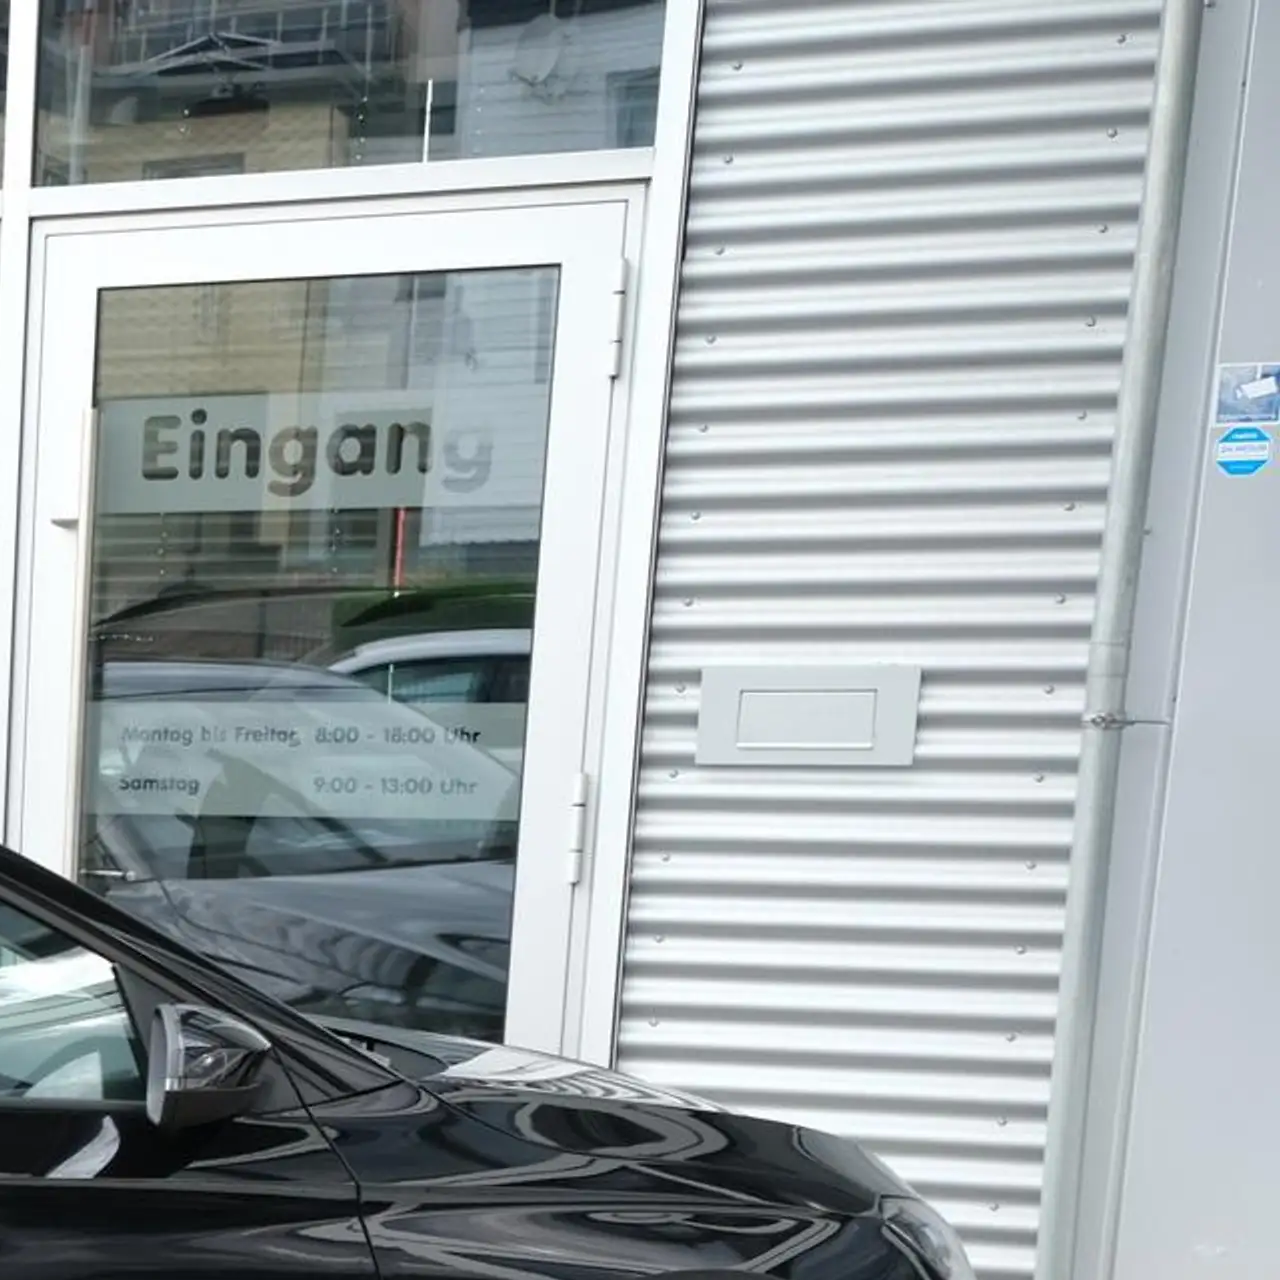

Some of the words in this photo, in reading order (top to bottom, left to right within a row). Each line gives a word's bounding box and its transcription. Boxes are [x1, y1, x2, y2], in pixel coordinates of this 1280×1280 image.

[142, 409, 494, 497] Eingang
[121, 726, 194, 747] Montag
[201, 725, 228, 743] bis
[235, 725, 302, 747] Freitag
[314, 726, 360, 744] 8:00
[383, 726, 436, 745] 18:00
[443, 725, 482, 744] Uhr
[118, 777, 200, 796] Samstag
[313, 776, 357, 794] 9:00
[380, 777, 433, 795] 13:00
[440, 778, 480, 795] Uhr
